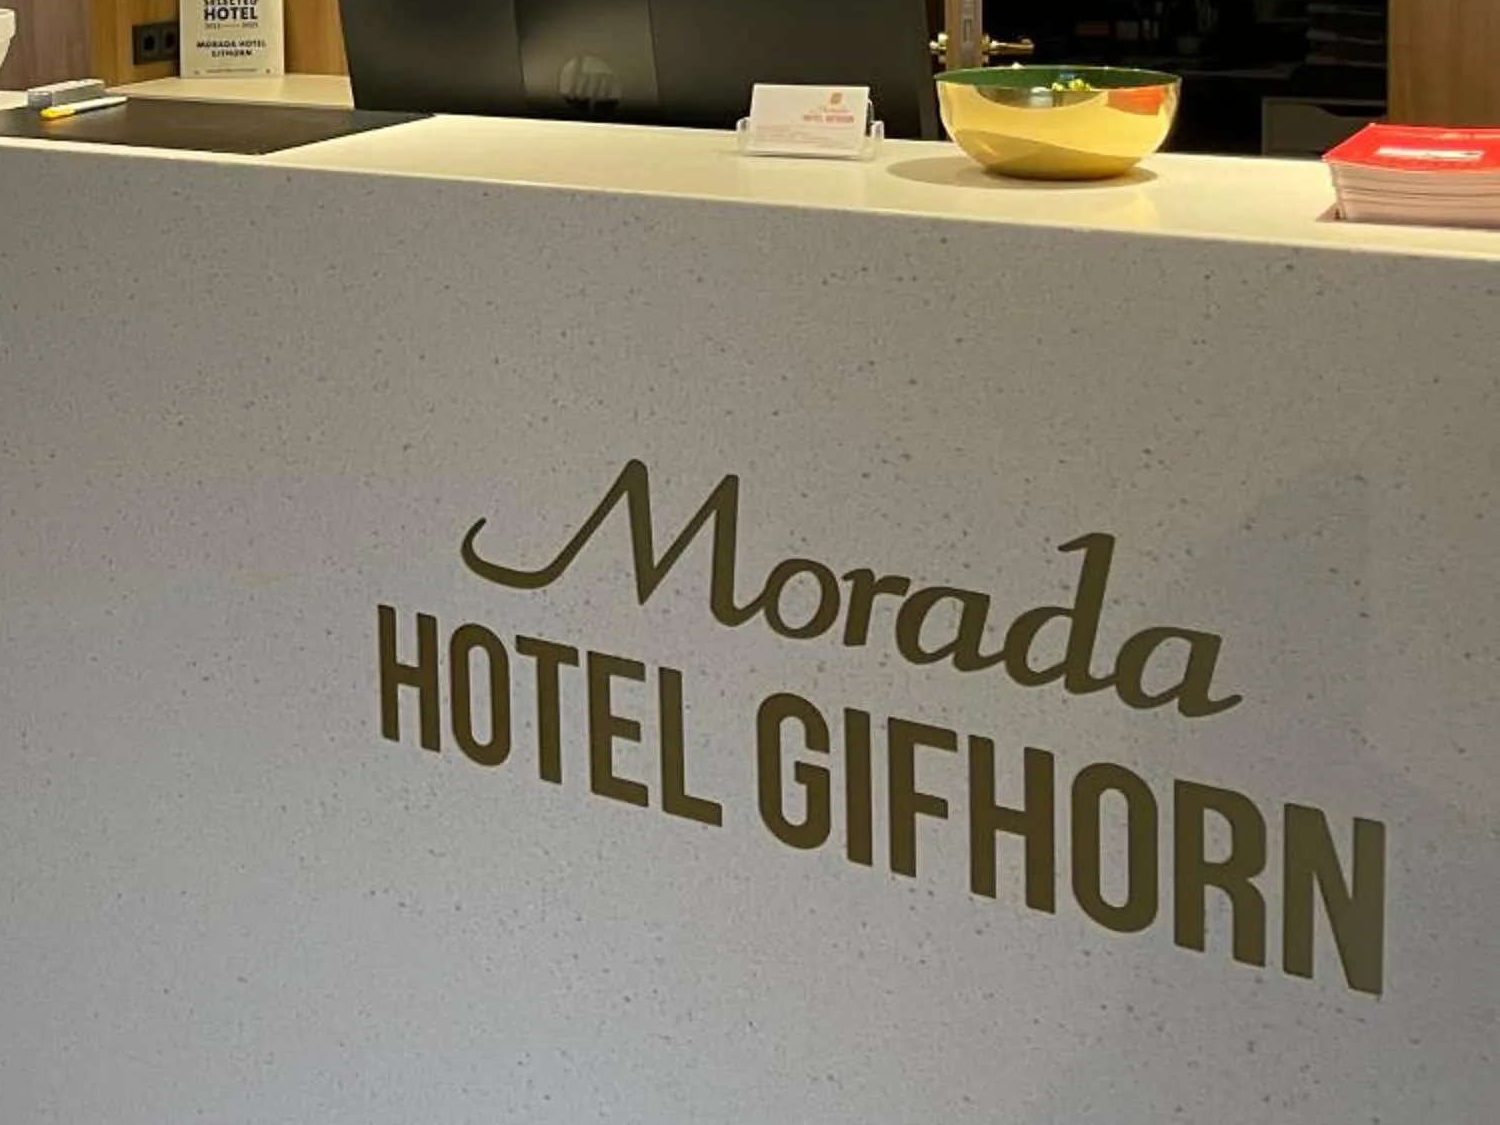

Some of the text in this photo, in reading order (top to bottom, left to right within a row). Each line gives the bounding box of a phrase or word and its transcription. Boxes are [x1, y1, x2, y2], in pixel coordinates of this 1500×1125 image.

[203, 7, 258, 21] HOTEL
[460, 458, 1244, 719] Morada
[376, 603, 1386, 998] HOTEL GIFHORN
